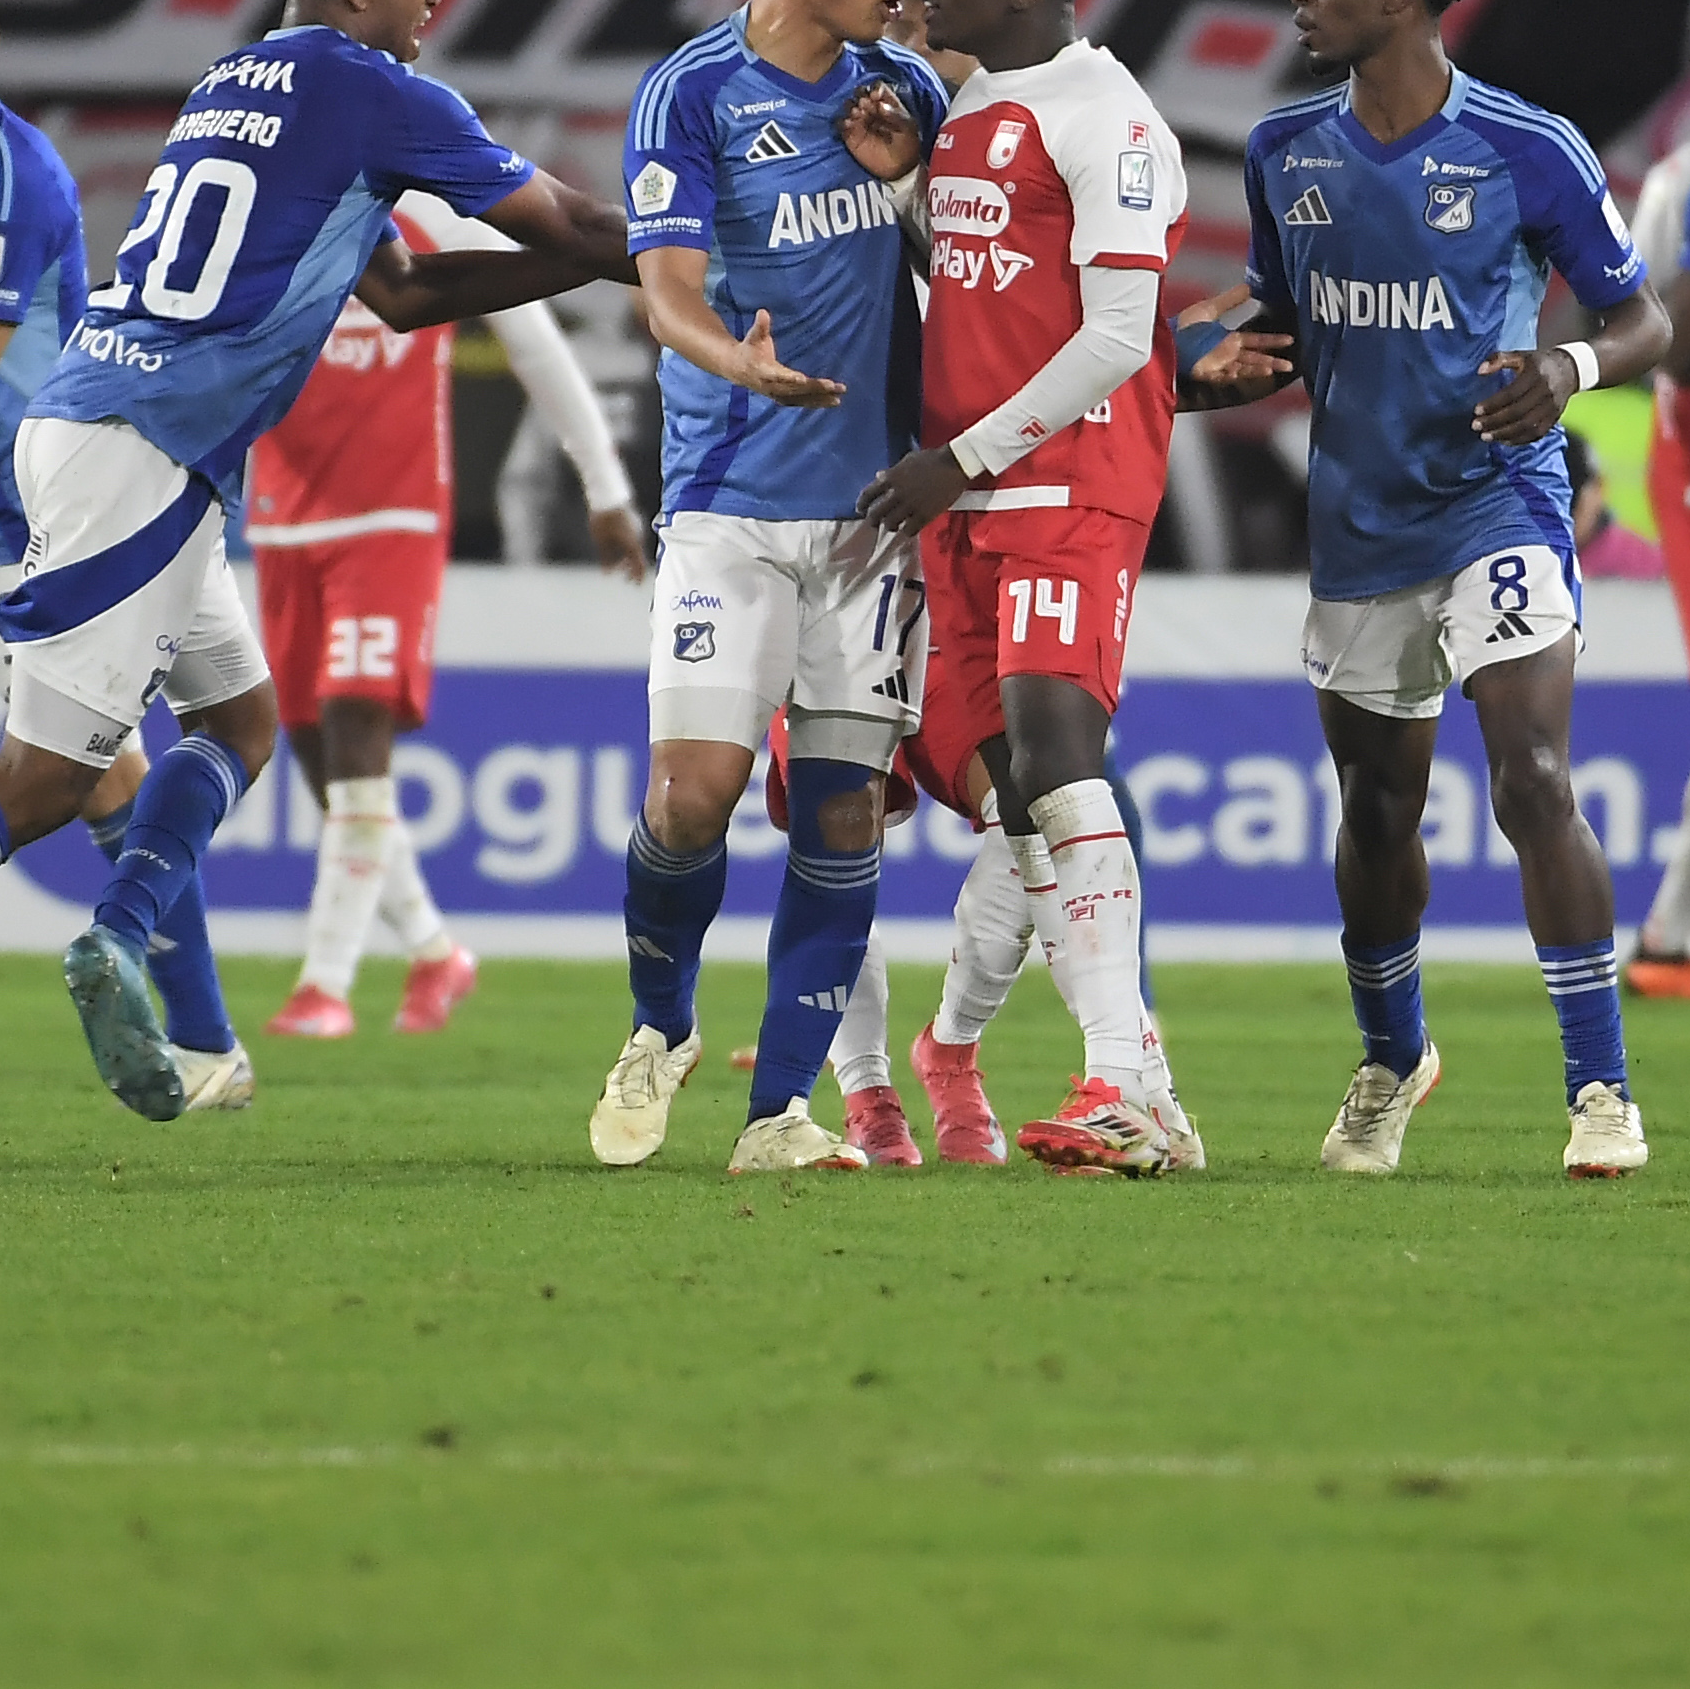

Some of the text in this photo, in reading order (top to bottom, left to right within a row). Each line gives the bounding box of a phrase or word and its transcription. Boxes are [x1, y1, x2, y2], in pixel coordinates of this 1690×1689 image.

[165, 109, 283, 148] ANGUERO
[87, 157, 258, 321] 20
[767, 180, 897, 249] ANDIN
[1311, 269, 1455, 331] ANDINA
[1007, 577, 1080, 646] 14
[1488, 553, 1529, 611] 8
[328, 616, 398, 679] 32
